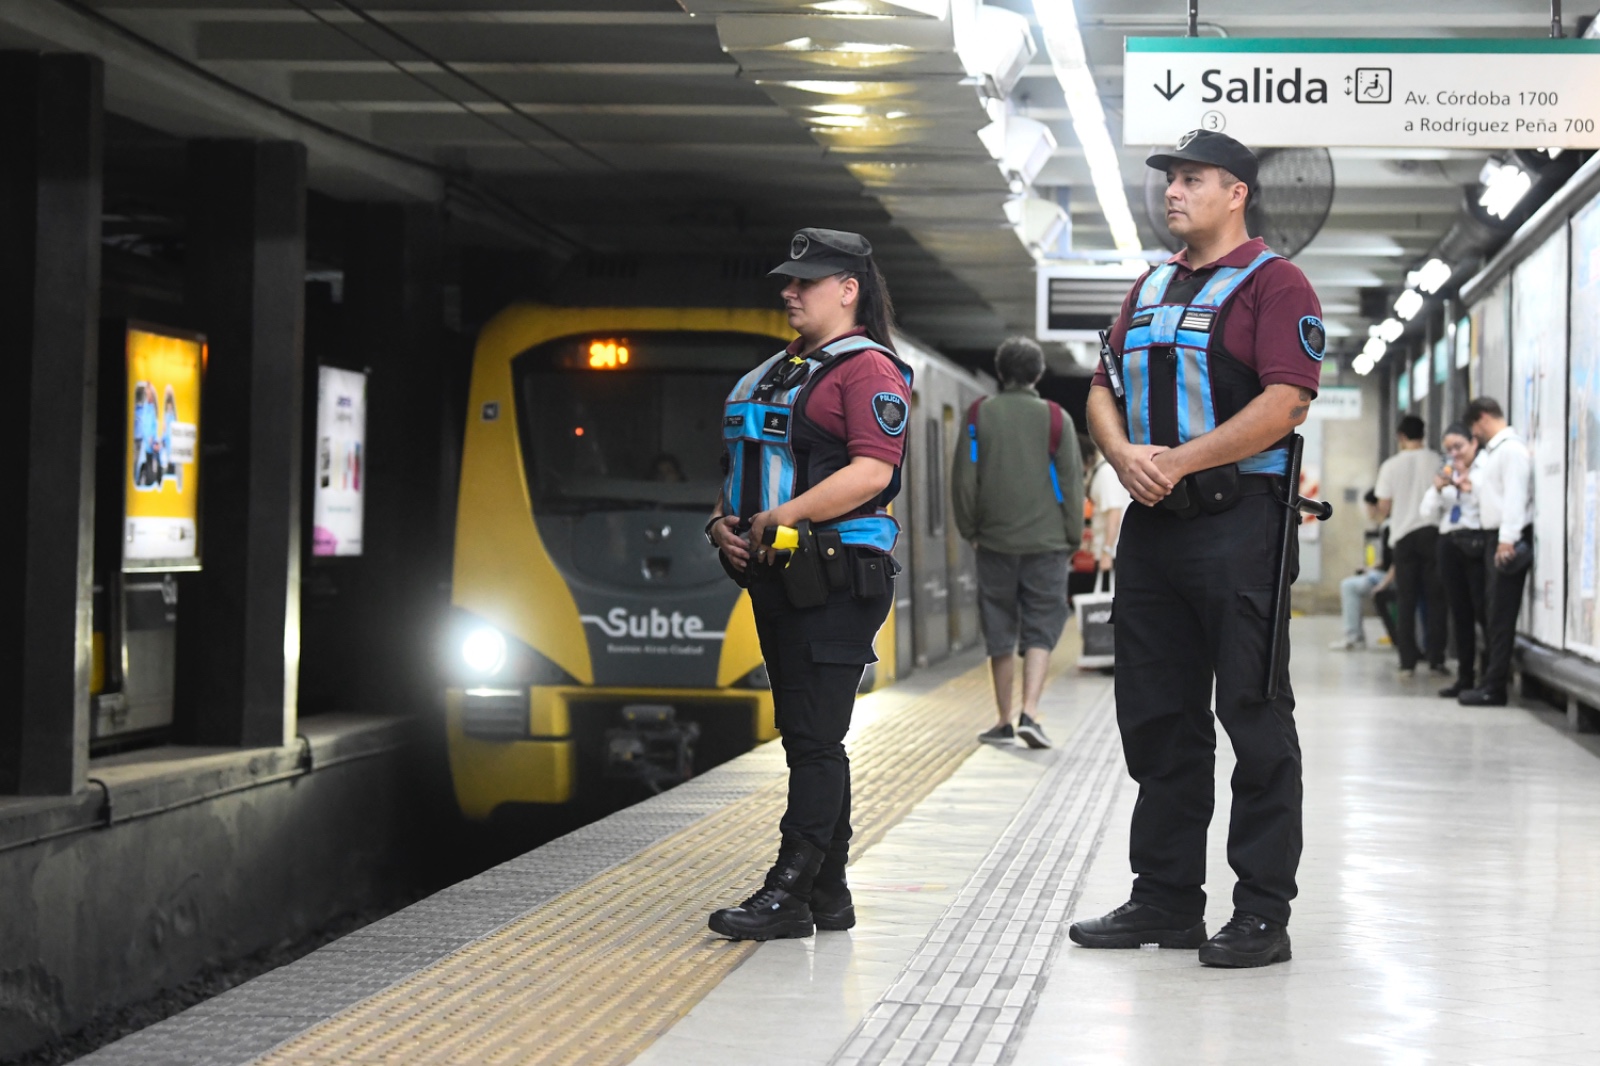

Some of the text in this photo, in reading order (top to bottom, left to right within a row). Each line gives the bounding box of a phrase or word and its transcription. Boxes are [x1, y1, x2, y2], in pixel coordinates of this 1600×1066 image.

[1201, 67, 1328, 104] Salida
[1405, 90, 1558, 105] Av. Córdoba 1700
[1209, 115, 1218, 130] 3
[1404, 117, 1595, 136] a Rodríguez Peña 700
[605, 607, 706, 639] Subte
